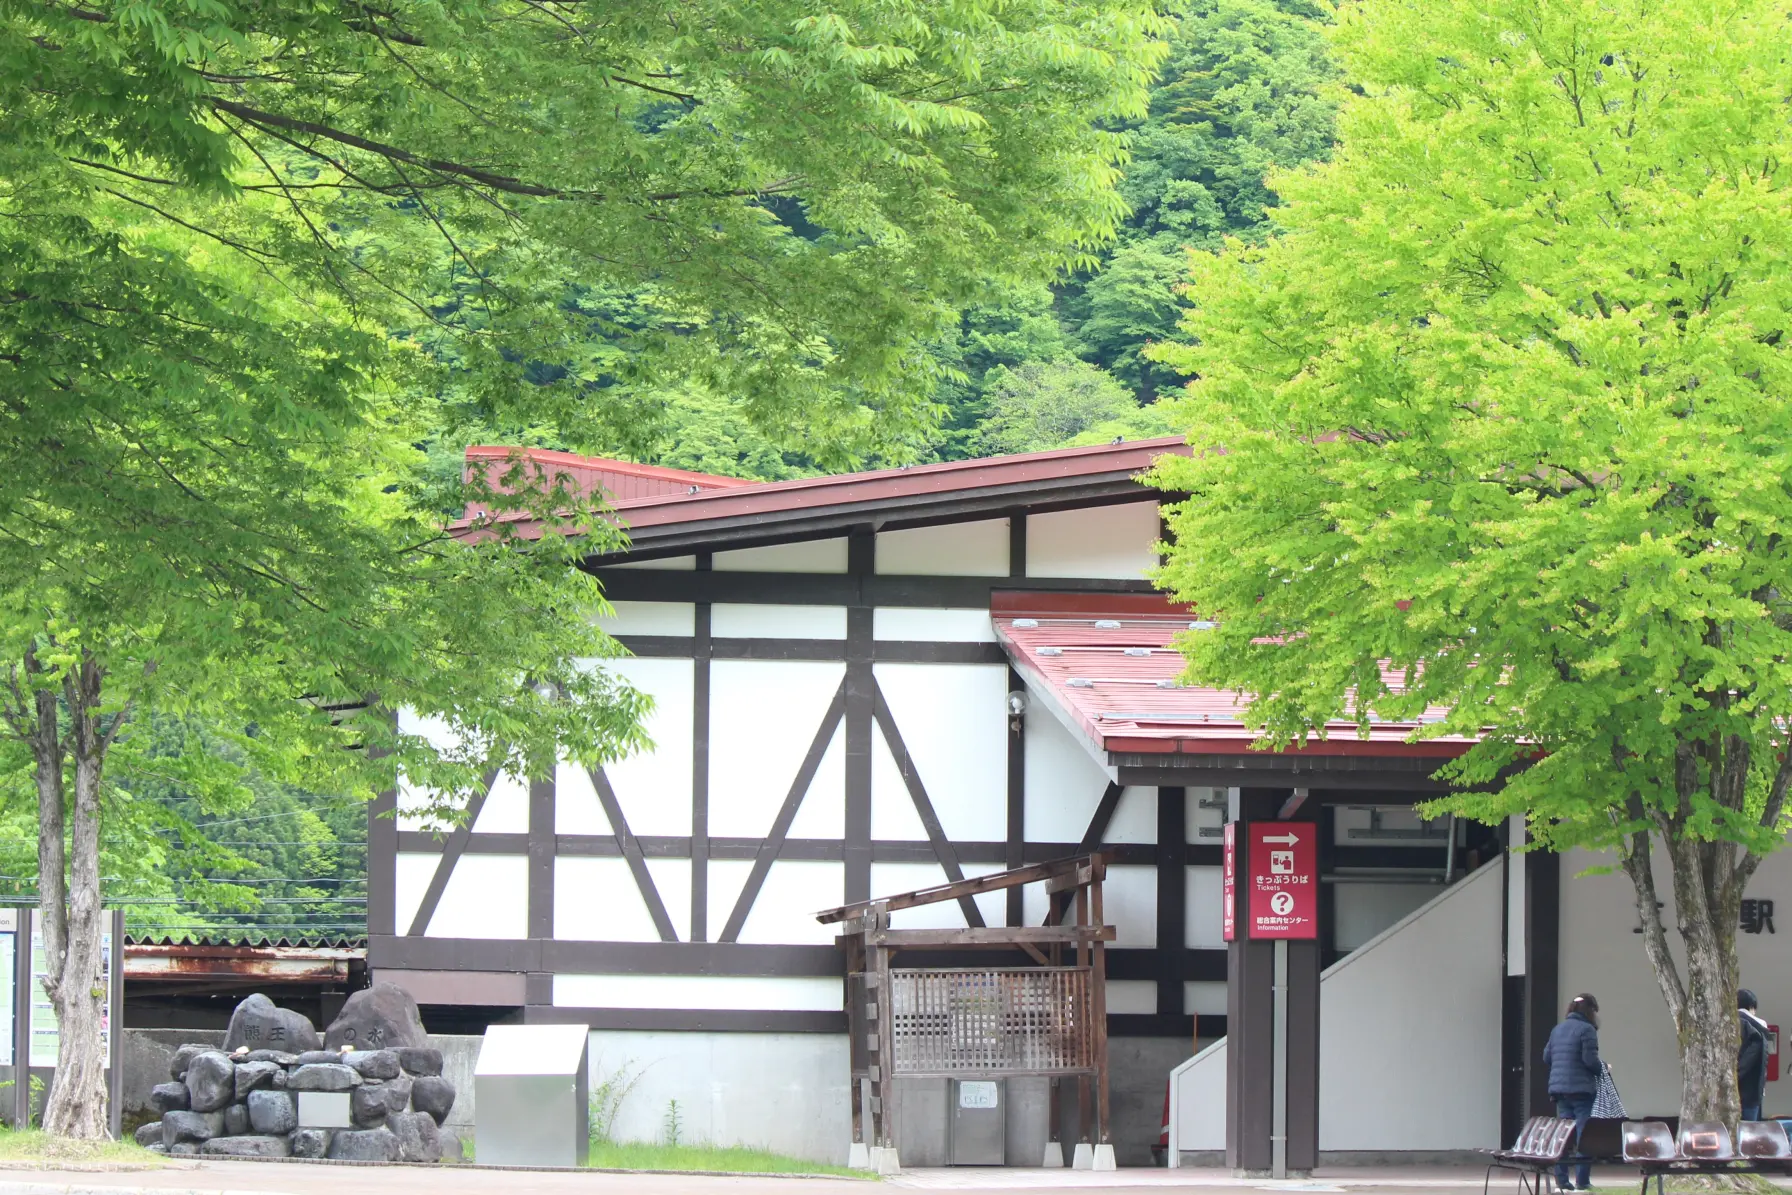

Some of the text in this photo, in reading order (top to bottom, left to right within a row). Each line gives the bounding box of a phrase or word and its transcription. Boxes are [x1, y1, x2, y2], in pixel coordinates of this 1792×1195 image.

[1256, 875, 1309, 884] きっぷうりば
